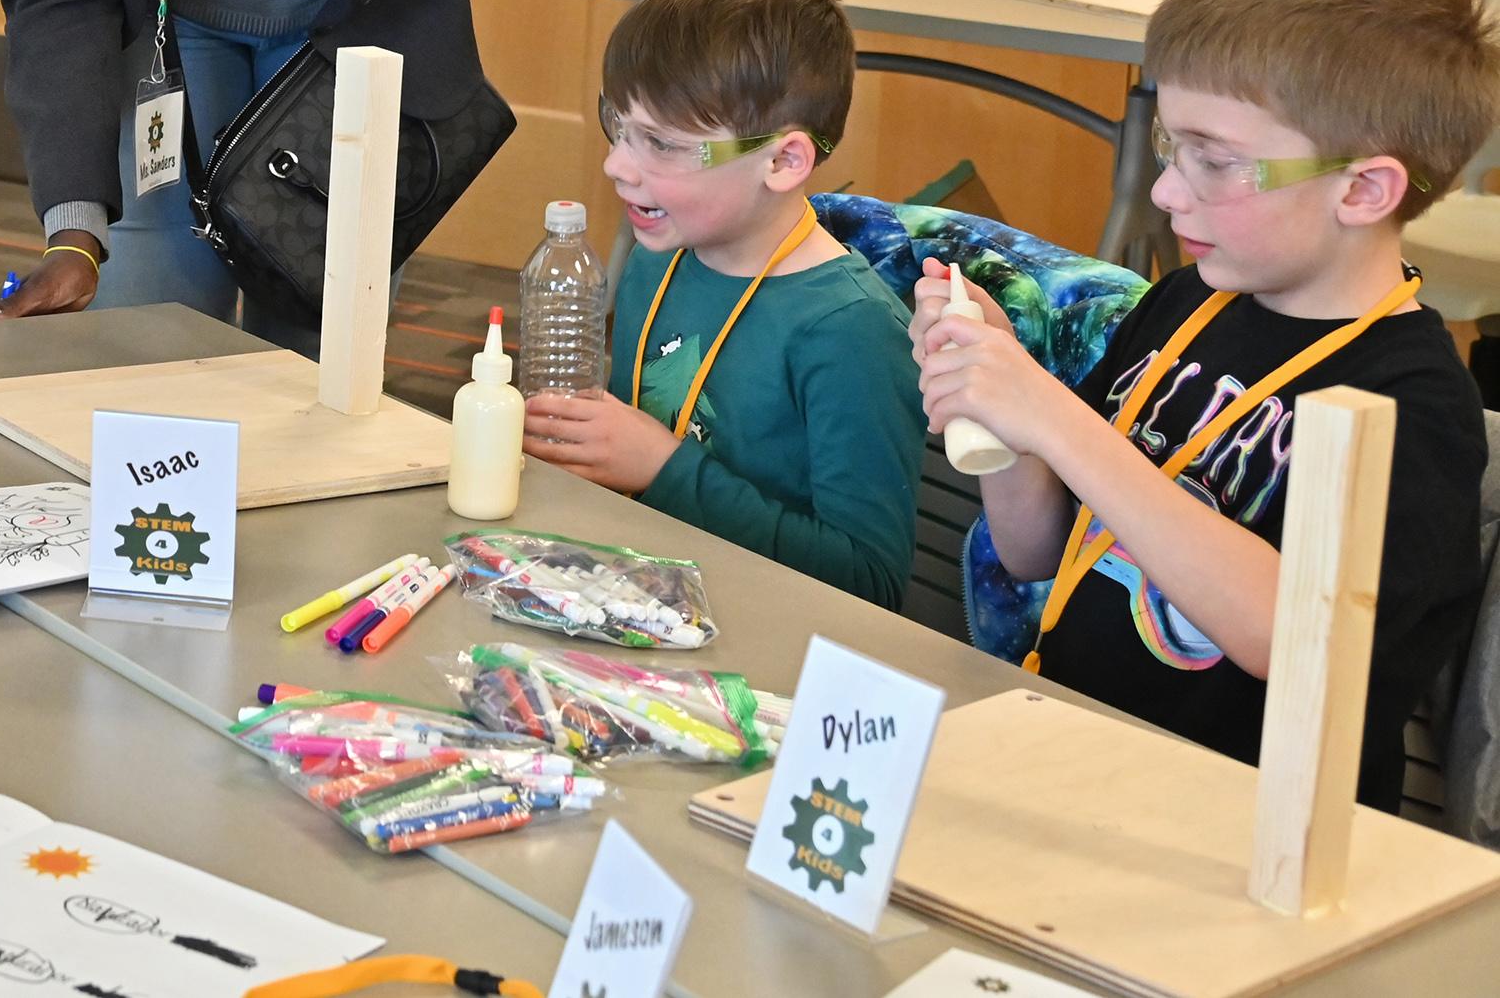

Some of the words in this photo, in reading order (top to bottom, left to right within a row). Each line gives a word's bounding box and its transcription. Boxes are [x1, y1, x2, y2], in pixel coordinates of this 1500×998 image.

[150, 156, 176, 176] Sanders
[126, 450, 200, 486] Isaac
[135, 516, 192, 532] STEM
[154, 539, 168, 549] 4
[136, 556, 188, 572] Kids
[822, 709, 896, 754] Dylan
[810, 790, 862, 827] STEM
[820, 828, 833, 842] 4
[796, 845, 844, 880] Kids
[584, 911, 662, 952] Jameson
